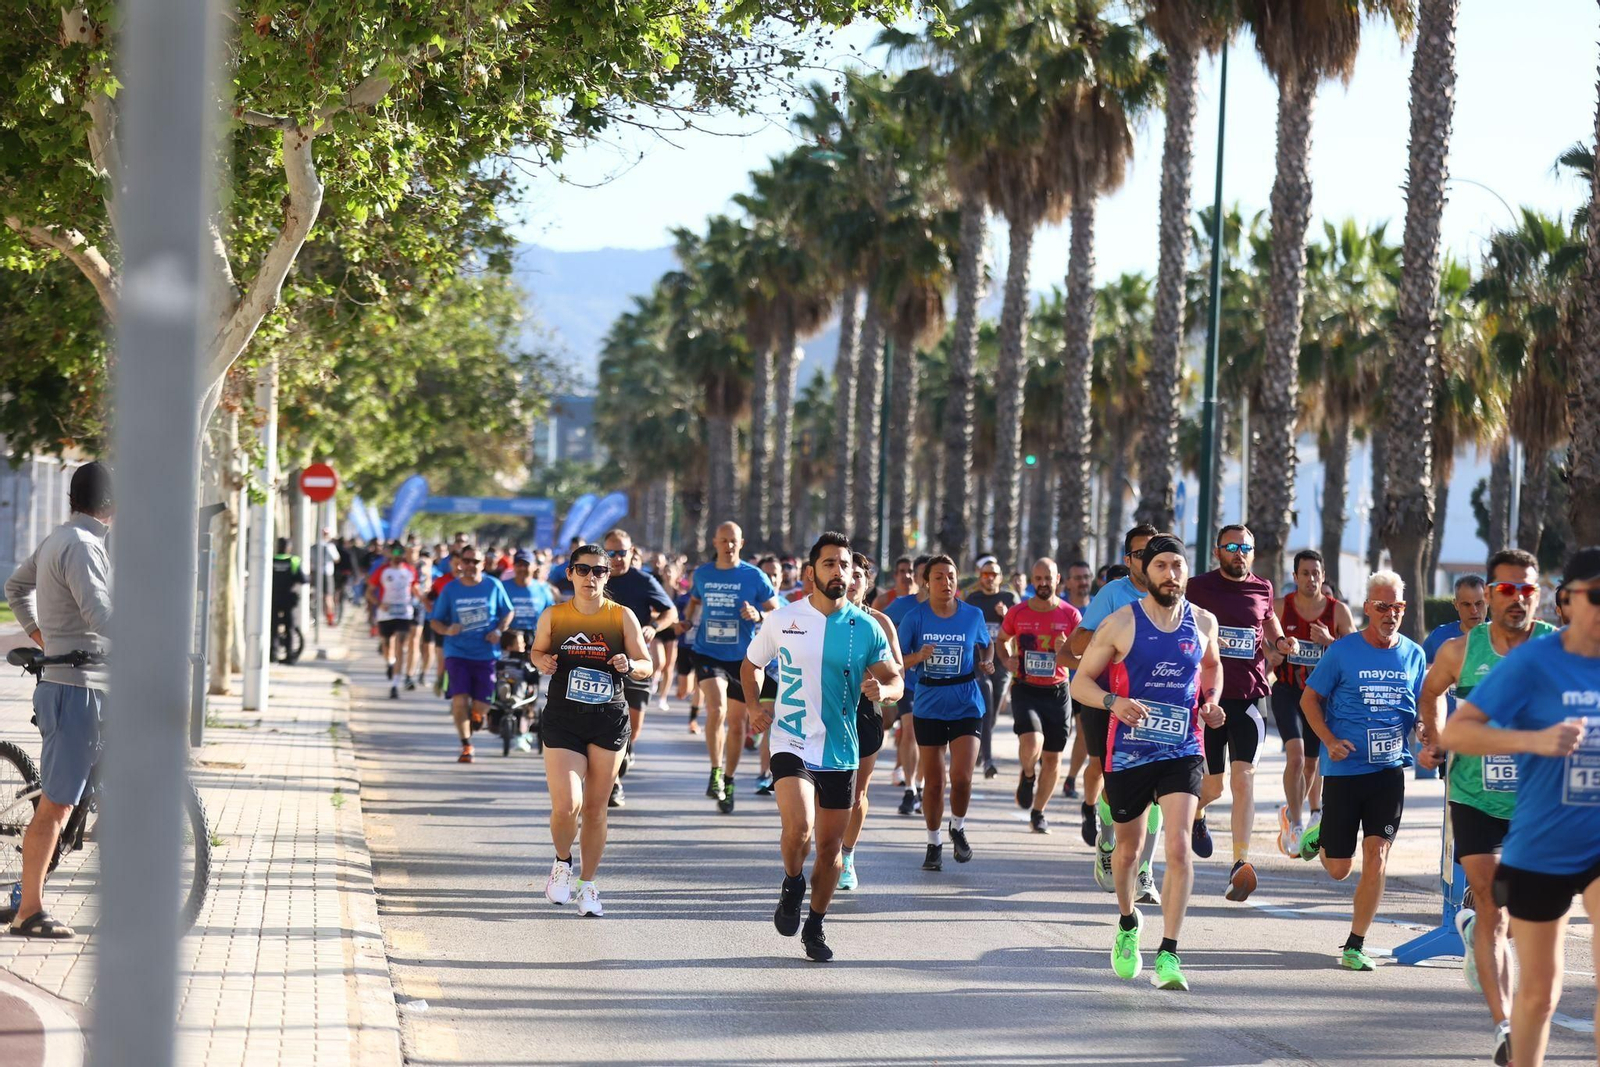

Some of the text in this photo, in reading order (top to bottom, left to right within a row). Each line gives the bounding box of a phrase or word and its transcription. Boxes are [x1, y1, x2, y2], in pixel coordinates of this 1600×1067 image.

[704, 582, 742, 590] mayoral
[923, 633, 966, 643] mayoral
[1229, 639, 1251, 648] 075
[930, 655, 957, 665] 1769
[1299, 650, 1320, 658] 005
[1151, 661, 1186, 677] Ford
[1359, 669, 1410, 681] mayoral
[574, 679, 609, 694] 1917
[777, 646, 807, 741] ANP
[1144, 716, 1182, 732] 1729
[1490, 766, 1518, 778] 16
